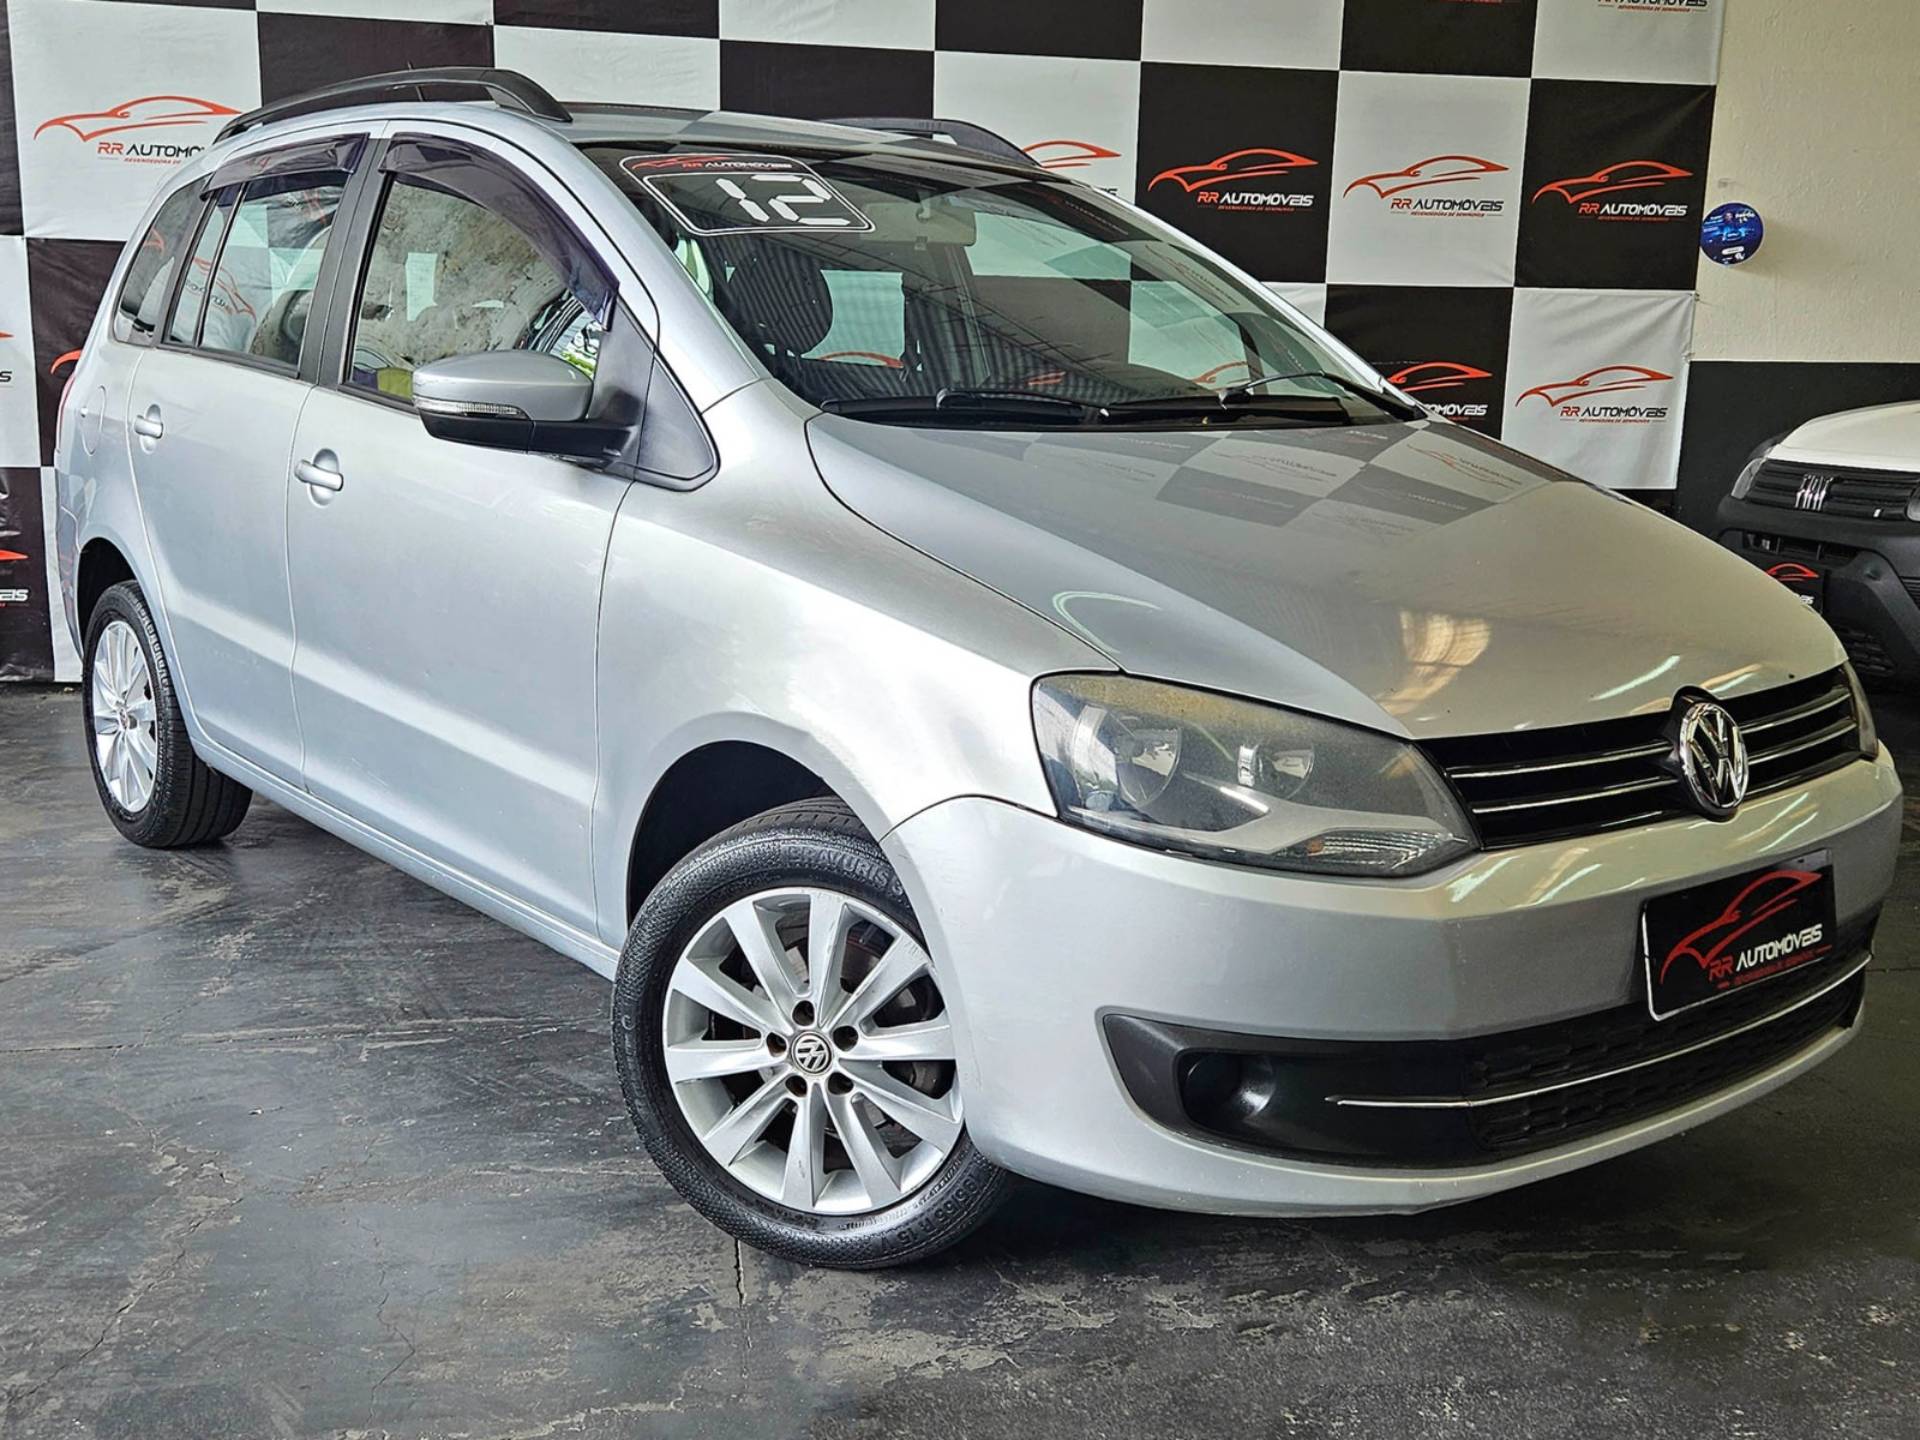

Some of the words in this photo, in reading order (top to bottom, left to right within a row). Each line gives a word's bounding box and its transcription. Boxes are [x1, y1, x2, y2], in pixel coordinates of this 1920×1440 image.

[97, 142, 124, 155] RR
[714, 173, 851, 226] 12
[1197, 191, 1220, 204] RR
[1391, 198, 1412, 210] RR
[1578, 202, 1600, 215] RR
[1560, 406, 1580, 417] RR
[1708, 954, 1734, 982] RR
